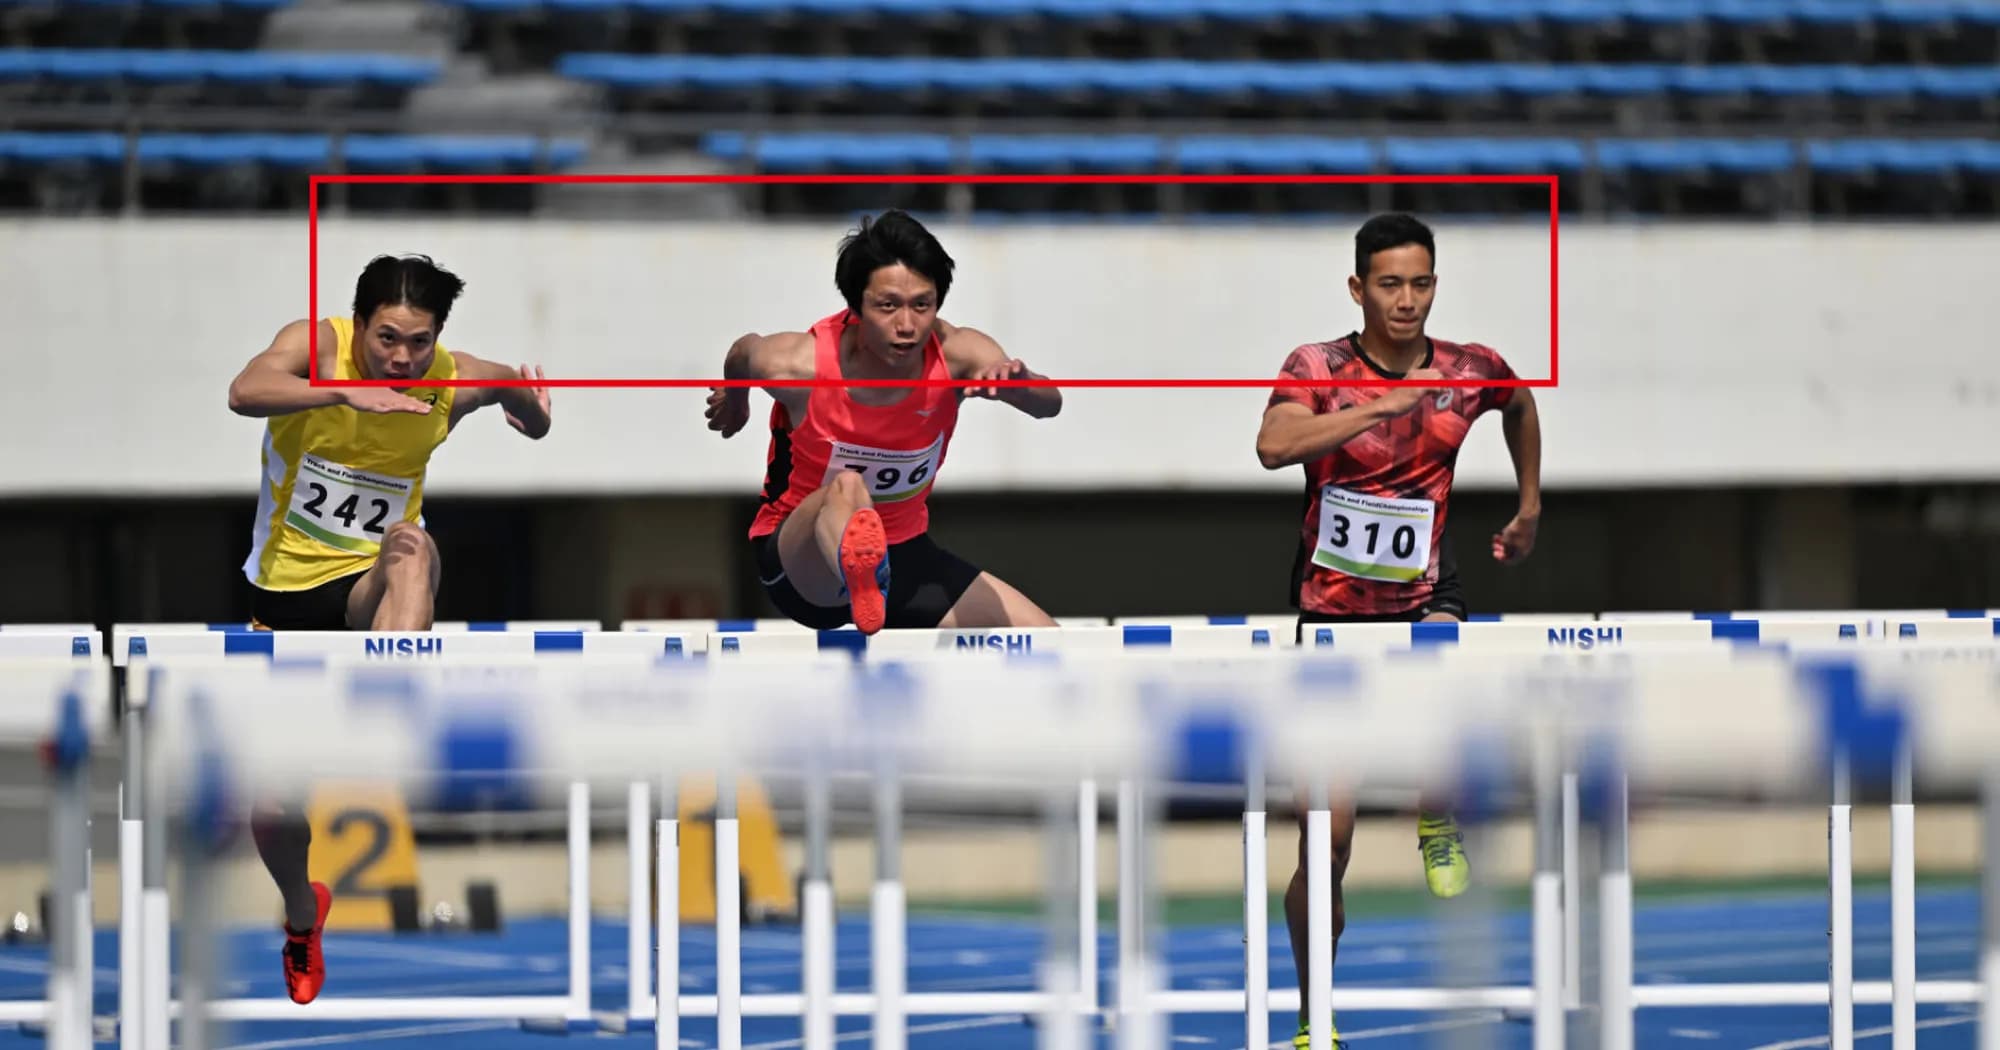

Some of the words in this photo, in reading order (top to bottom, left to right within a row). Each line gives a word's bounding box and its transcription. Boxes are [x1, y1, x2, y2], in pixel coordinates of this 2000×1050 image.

[327, 467, 341, 477] and
[303, 482, 389, 534] 242
[1347, 496, 1360, 504] and
[1330, 514, 1416, 560] 310
[364, 638, 442, 657] NISHI
[1547, 626, 1623, 650] NISHI
[329, 807, 392, 898] 2
